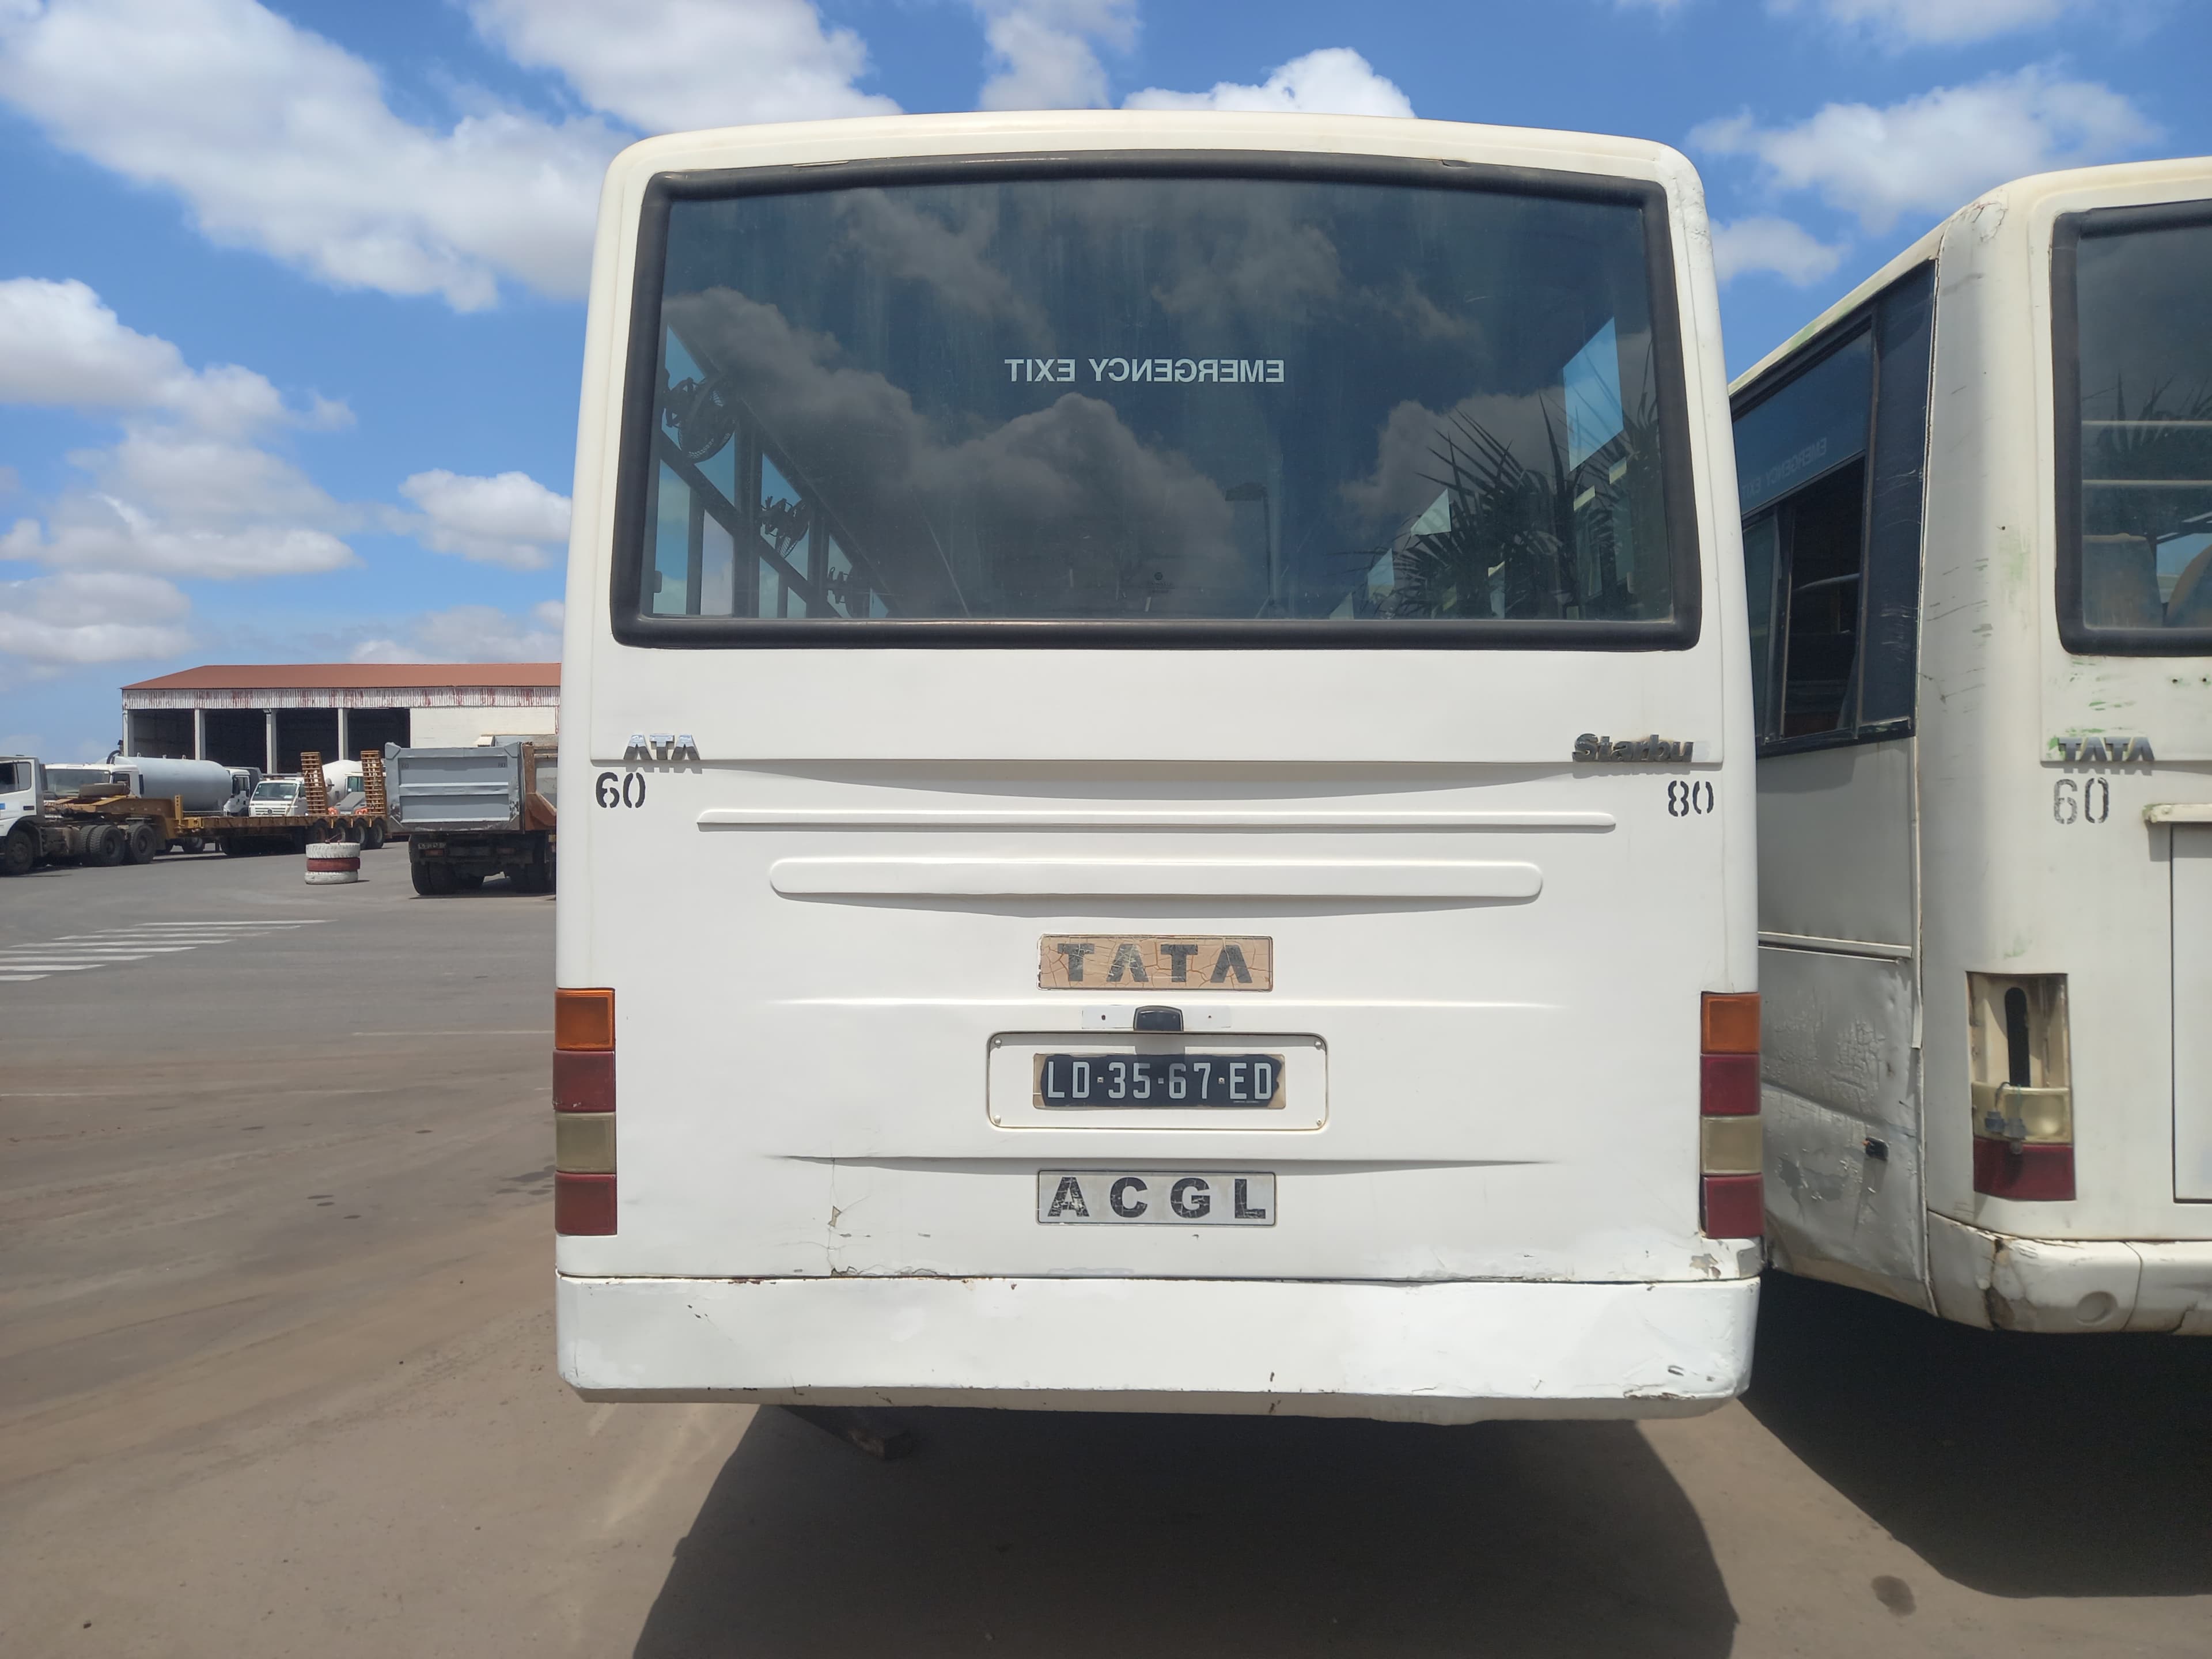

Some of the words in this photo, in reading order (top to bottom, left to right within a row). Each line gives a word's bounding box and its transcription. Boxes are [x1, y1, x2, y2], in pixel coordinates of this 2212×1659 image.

[623, 733, 700, 760] ATA
[2058, 737, 2155, 762] TATA
[596, 772, 646, 808] 60
[1668, 780, 1714, 817] 80
[2054, 778, 2109, 824] 60
[1057, 943, 1253, 984] TATA
